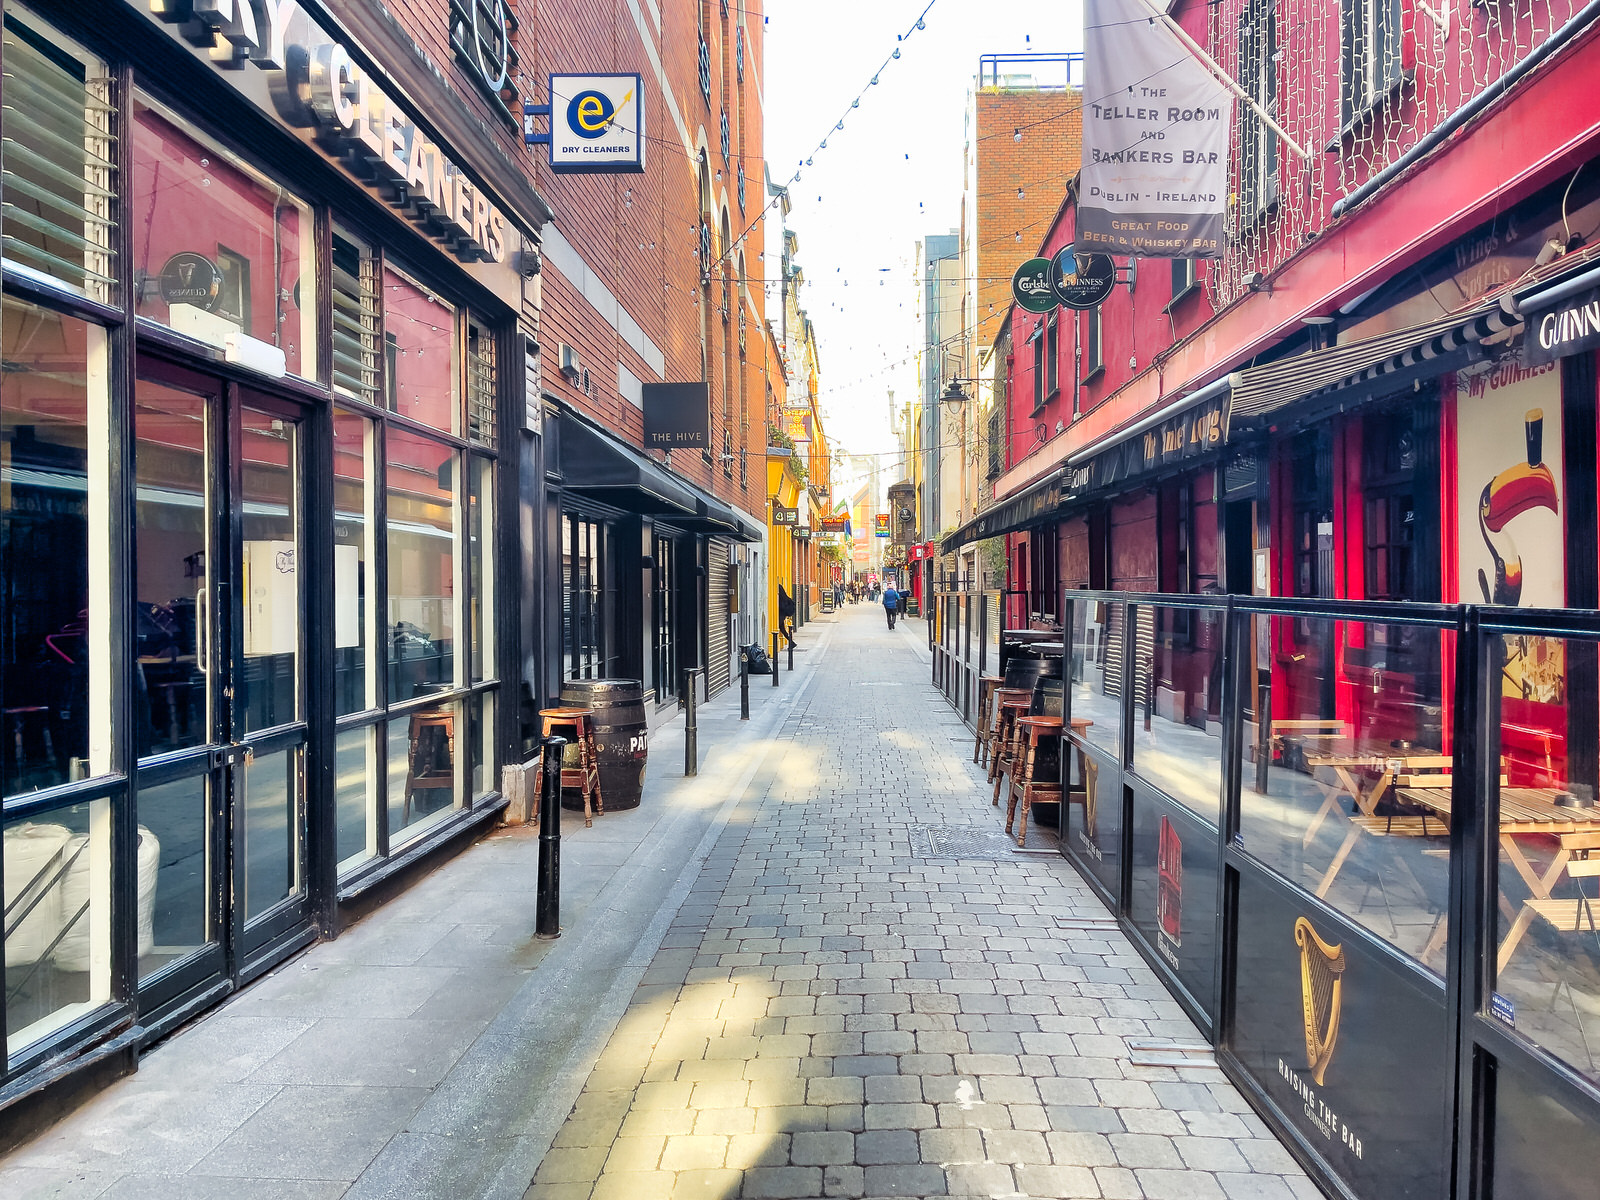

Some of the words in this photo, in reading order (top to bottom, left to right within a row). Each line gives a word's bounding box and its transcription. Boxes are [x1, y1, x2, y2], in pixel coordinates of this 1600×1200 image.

[1141, 87, 1167, 97] THE
[1092, 104, 1159, 121] TELLER
[1167, 107, 1220, 122] ROOM
[1140, 131, 1166, 140] AND
[330, 43, 505, 263] CLEANERS
[562, 145, 580, 154] DRY
[583, 145, 630, 154] CLEANERS
[1092, 148, 1174, 164] BANKERS
[1182, 150, 1218, 165] BAR
[1090, 186, 1139, 202] DUBLIN
[1156, 191, 1217, 203] IRELAND
[1111, 220, 1152, 231] GREAT
[1157, 221, 1189, 231] FOOD
[1083, 231, 1115, 243] BEER
[1119, 236, 1128, 245] &
[1131, 237, 1188, 249] WHISKEY
[1192, 238, 1217, 248] BAR
[1455, 233, 1500, 269] Wines
[1459, 261, 1510, 301] Spirits
[652, 433, 672, 441] THE
[676, 432, 702, 441] HIVE
[1278, 1057, 1316, 1110] RAISING
[1318, 1099, 1338, 1133] THE
[1342, 1123, 1363, 1160] BAR
[1303, 1102, 1331, 1141] GUINNESS
